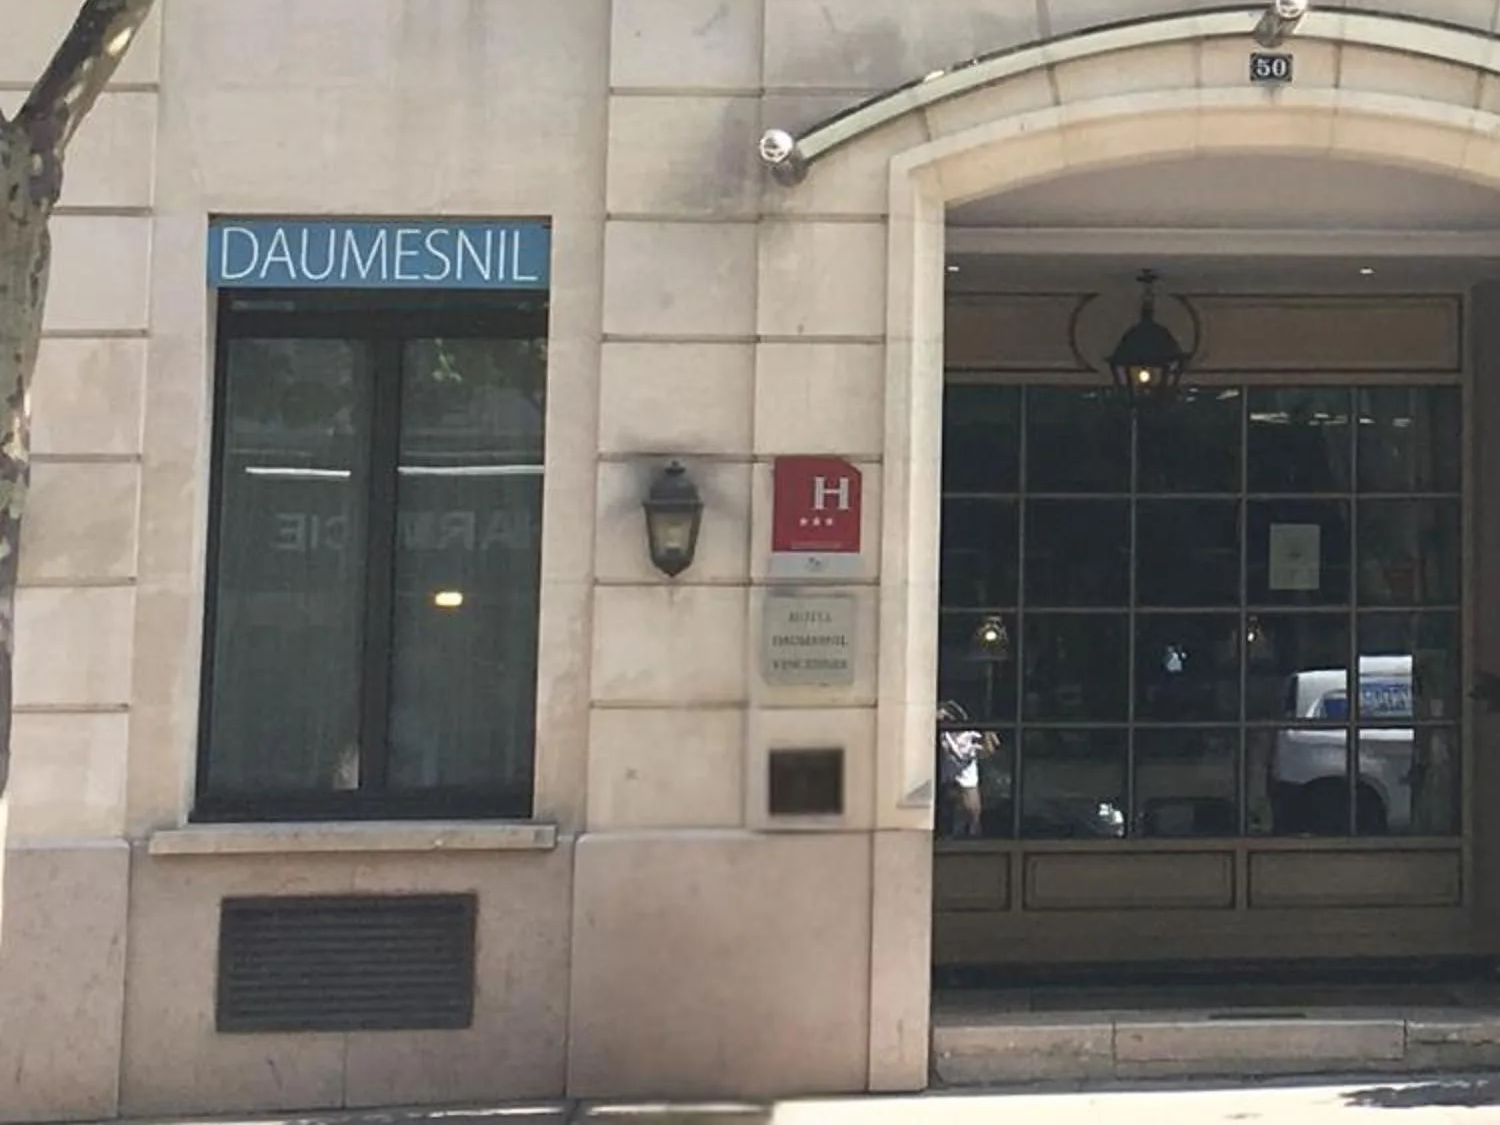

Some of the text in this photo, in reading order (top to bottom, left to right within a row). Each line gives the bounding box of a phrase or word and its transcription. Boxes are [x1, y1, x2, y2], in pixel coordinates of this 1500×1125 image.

[1256, 58, 1287, 77] 50
[220, 227, 540, 282] DAUMESNIL
[811, 475, 851, 511] H
